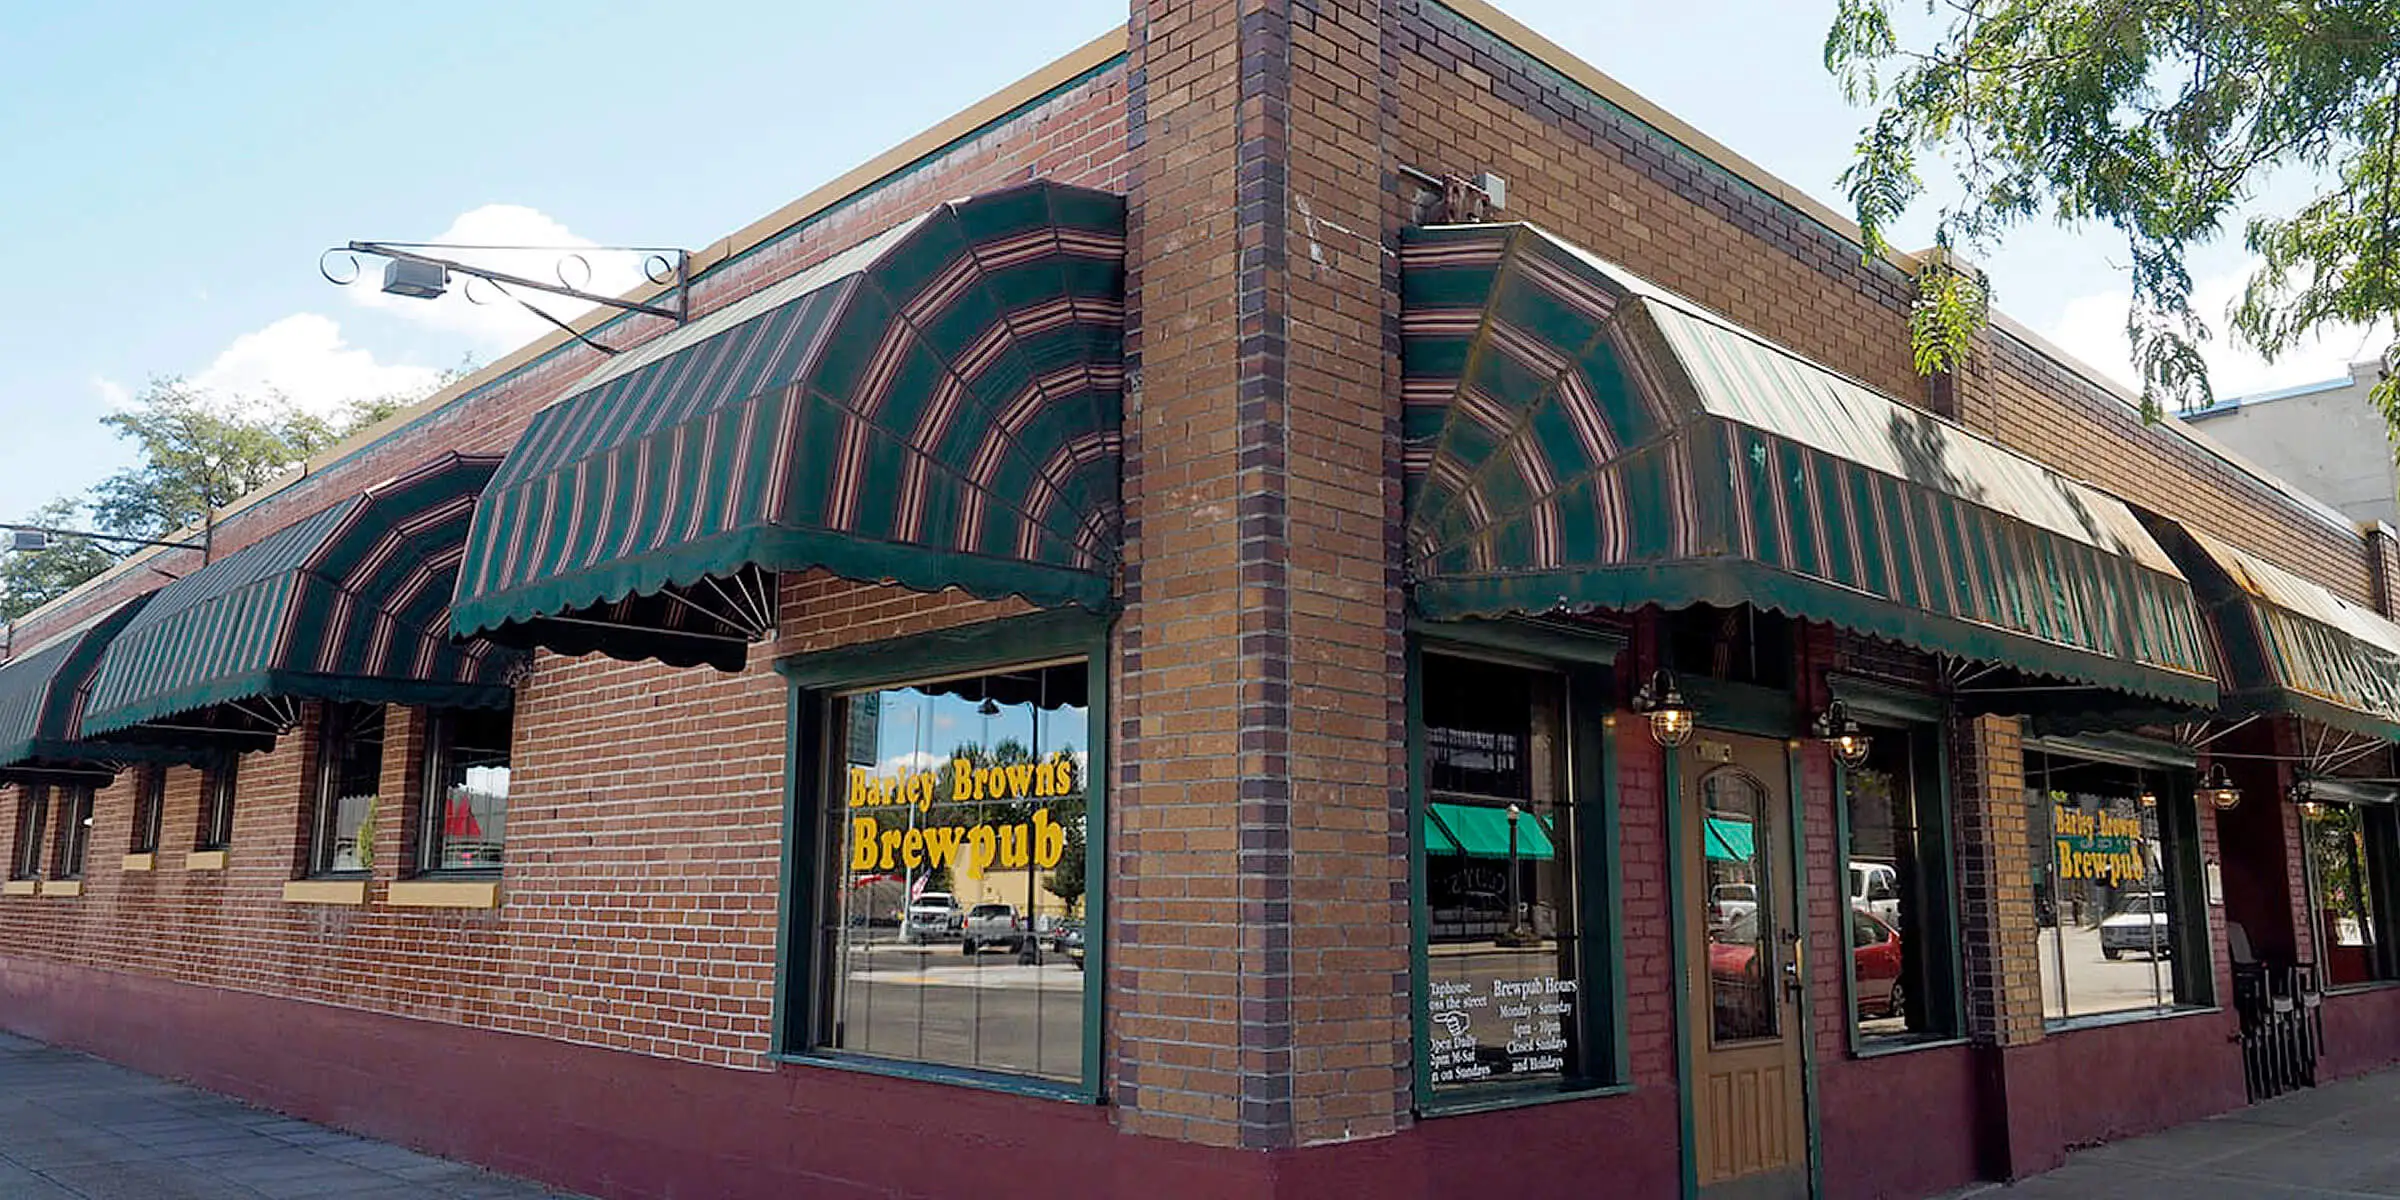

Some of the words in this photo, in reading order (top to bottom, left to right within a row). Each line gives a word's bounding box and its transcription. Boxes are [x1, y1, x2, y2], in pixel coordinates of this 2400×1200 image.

[849, 766, 937, 813] Barley
[953, 752, 1072, 801] Brown's
[2055, 804, 2094, 842] Barley
[851, 808, 1064, 880] Brewpub
[2058, 840, 2144, 888] Brewpub
[1430, 981, 1471, 998] Taphouse
[1494, 977, 1543, 1001] Brewpub
[1545, 976, 1578, 993] Hours
[1446, 995, 1461, 1010] the
[1463, 996, 1487, 1009] street
[1499, 1002, 1532, 1019] Monday
[1506, 1038, 1534, 1055] Closed
[1512, 1057, 1529, 1072] and
